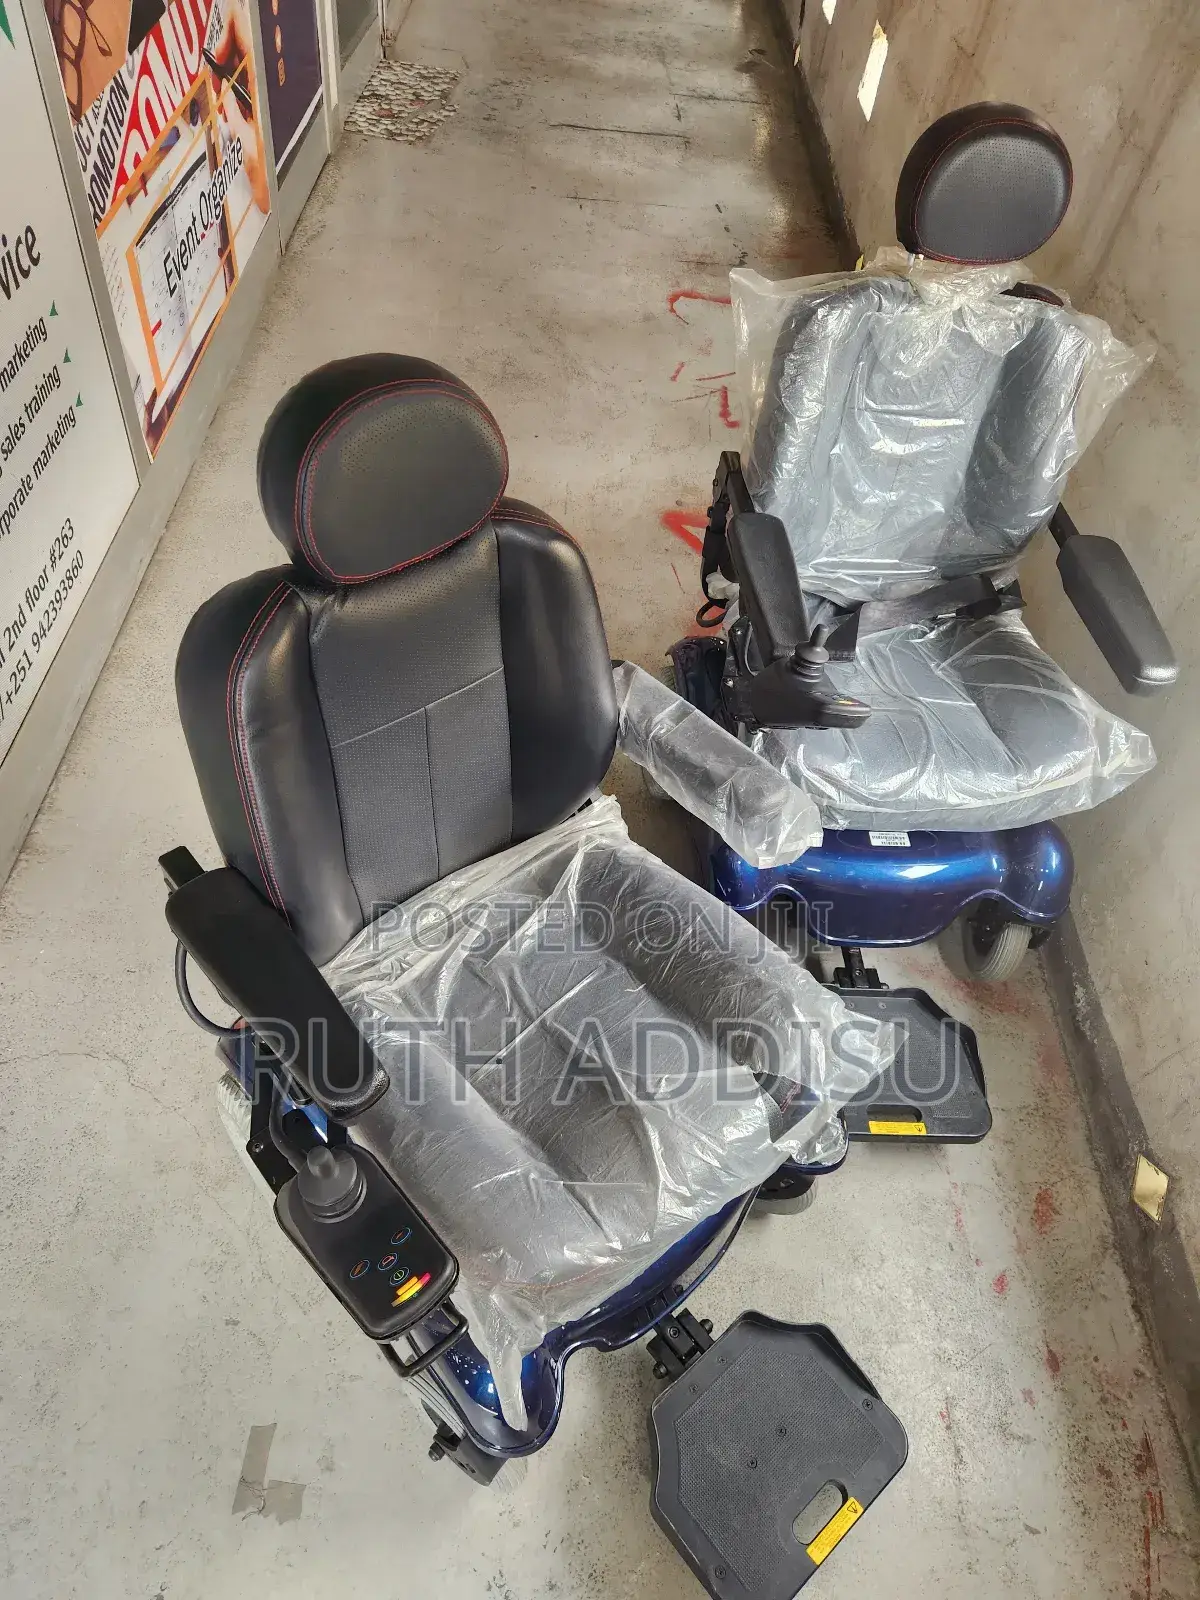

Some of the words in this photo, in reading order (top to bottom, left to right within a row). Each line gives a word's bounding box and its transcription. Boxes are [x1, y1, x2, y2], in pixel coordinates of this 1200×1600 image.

[163, 216, 200, 298] Event
[199, 136, 243, 228] Organize
[0, 316, 48, 392] marketing
[1, 417, 26, 461] sales
[25, 364, 61, 423] training
[33, 405, 77, 480] marketing
[3, 605, 27, 648] 2nd
[25, 565, 49, 614] floor
[49, 517, 75, 573] #263
[5, 652, 33, 706] +251
[31, 549, 84, 653] 942393860
